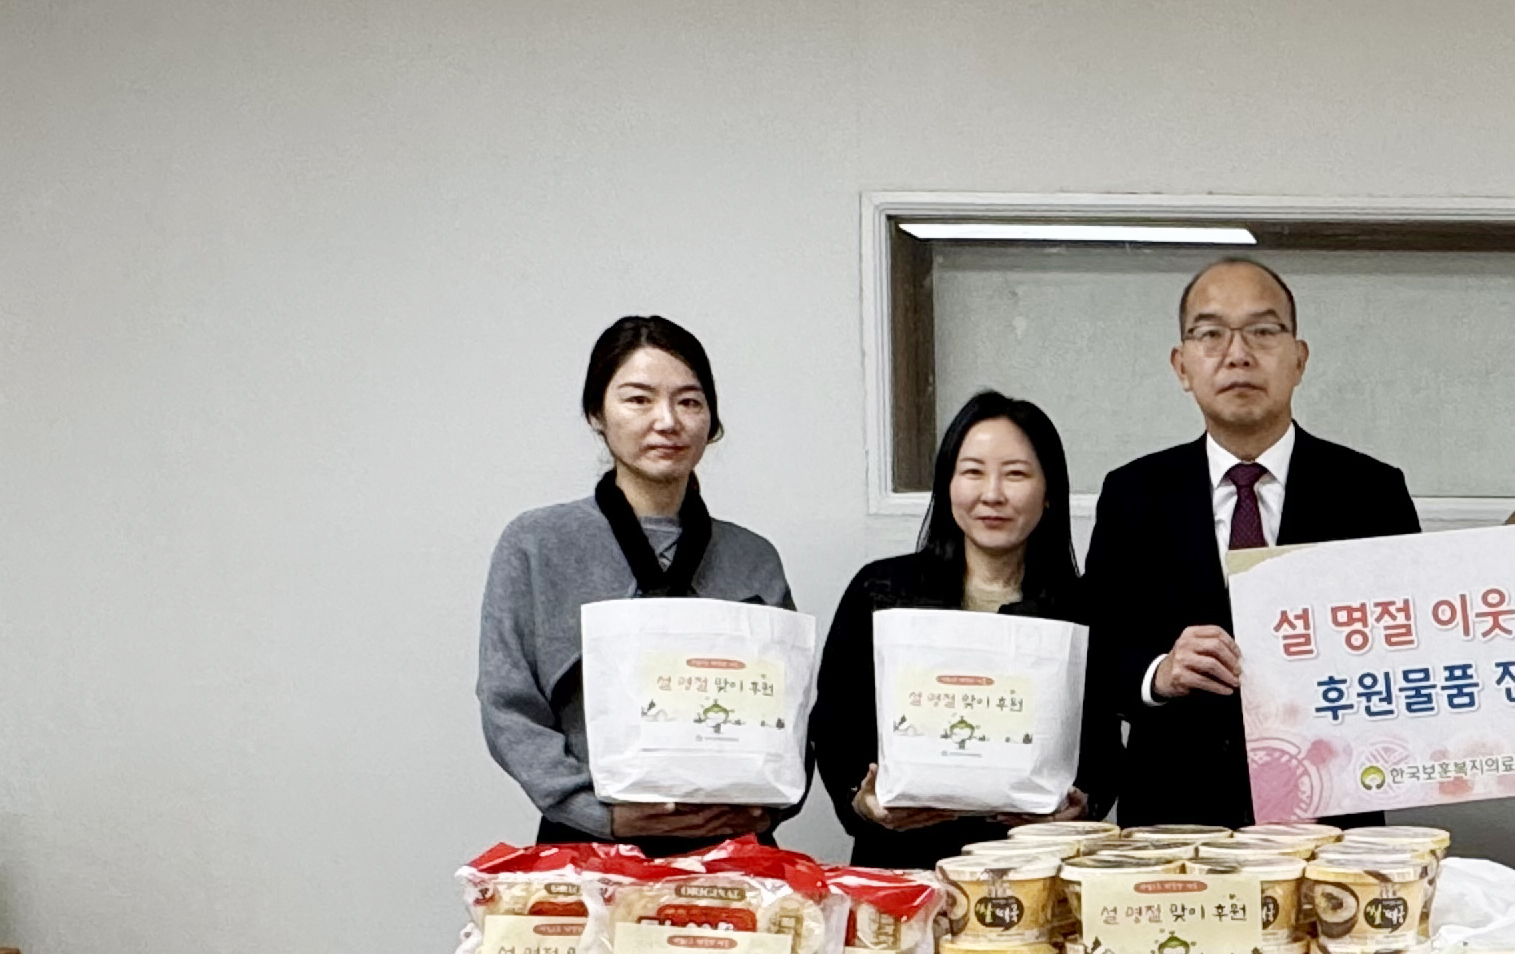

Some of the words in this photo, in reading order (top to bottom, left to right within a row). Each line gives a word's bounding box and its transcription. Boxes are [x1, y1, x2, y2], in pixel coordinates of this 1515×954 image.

[1274, 608, 1314, 657] 설
[1331, 598, 1415, 652] 명절
[1315, 664, 1480, 720] 후원물품
[681, 886, 741, 899] ORIGINAL
[1101, 905, 1119, 925] 설
[1125, 905, 1162, 924] 명절
[1170, 904, 1205, 922] 맞이
[1212, 904, 1247, 921] 후원
